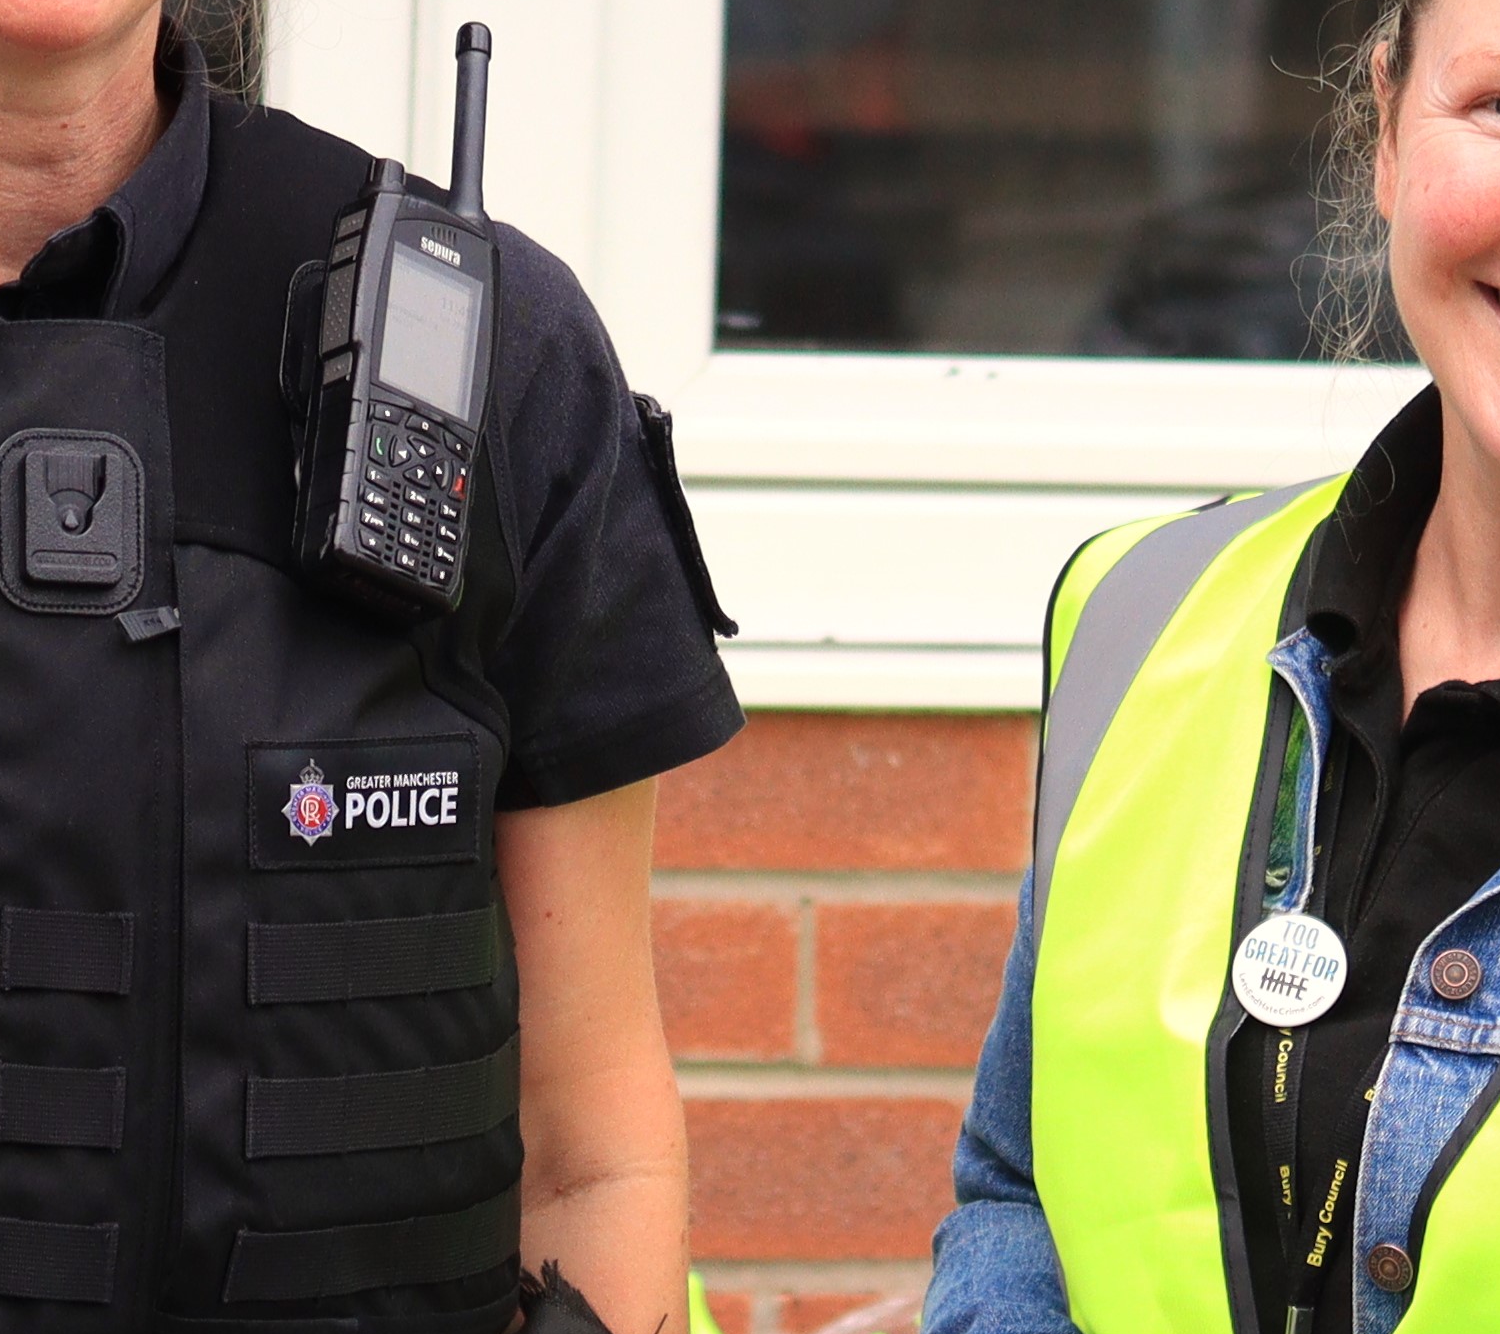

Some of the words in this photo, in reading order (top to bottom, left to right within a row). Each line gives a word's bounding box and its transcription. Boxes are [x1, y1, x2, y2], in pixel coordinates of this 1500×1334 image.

[420, 236, 461, 266] sepura
[346, 775, 392, 790] GREATER
[393, 771, 459, 788] MANCHESTER
[345, 787, 459, 830] POLICE
[1283, 920, 1320, 950] TOO
[1244, 937, 1303, 972] GREAT
[1301, 953, 1340, 983] FOR
[1259, 967, 1310, 1002] HATE
[1274, 1038, 1294, 1104] Council
[1279, 1164, 1293, 1206] Bury
[1318, 1157, 1349, 1225] Council
[1306, 1225, 1334, 1268] Bury
